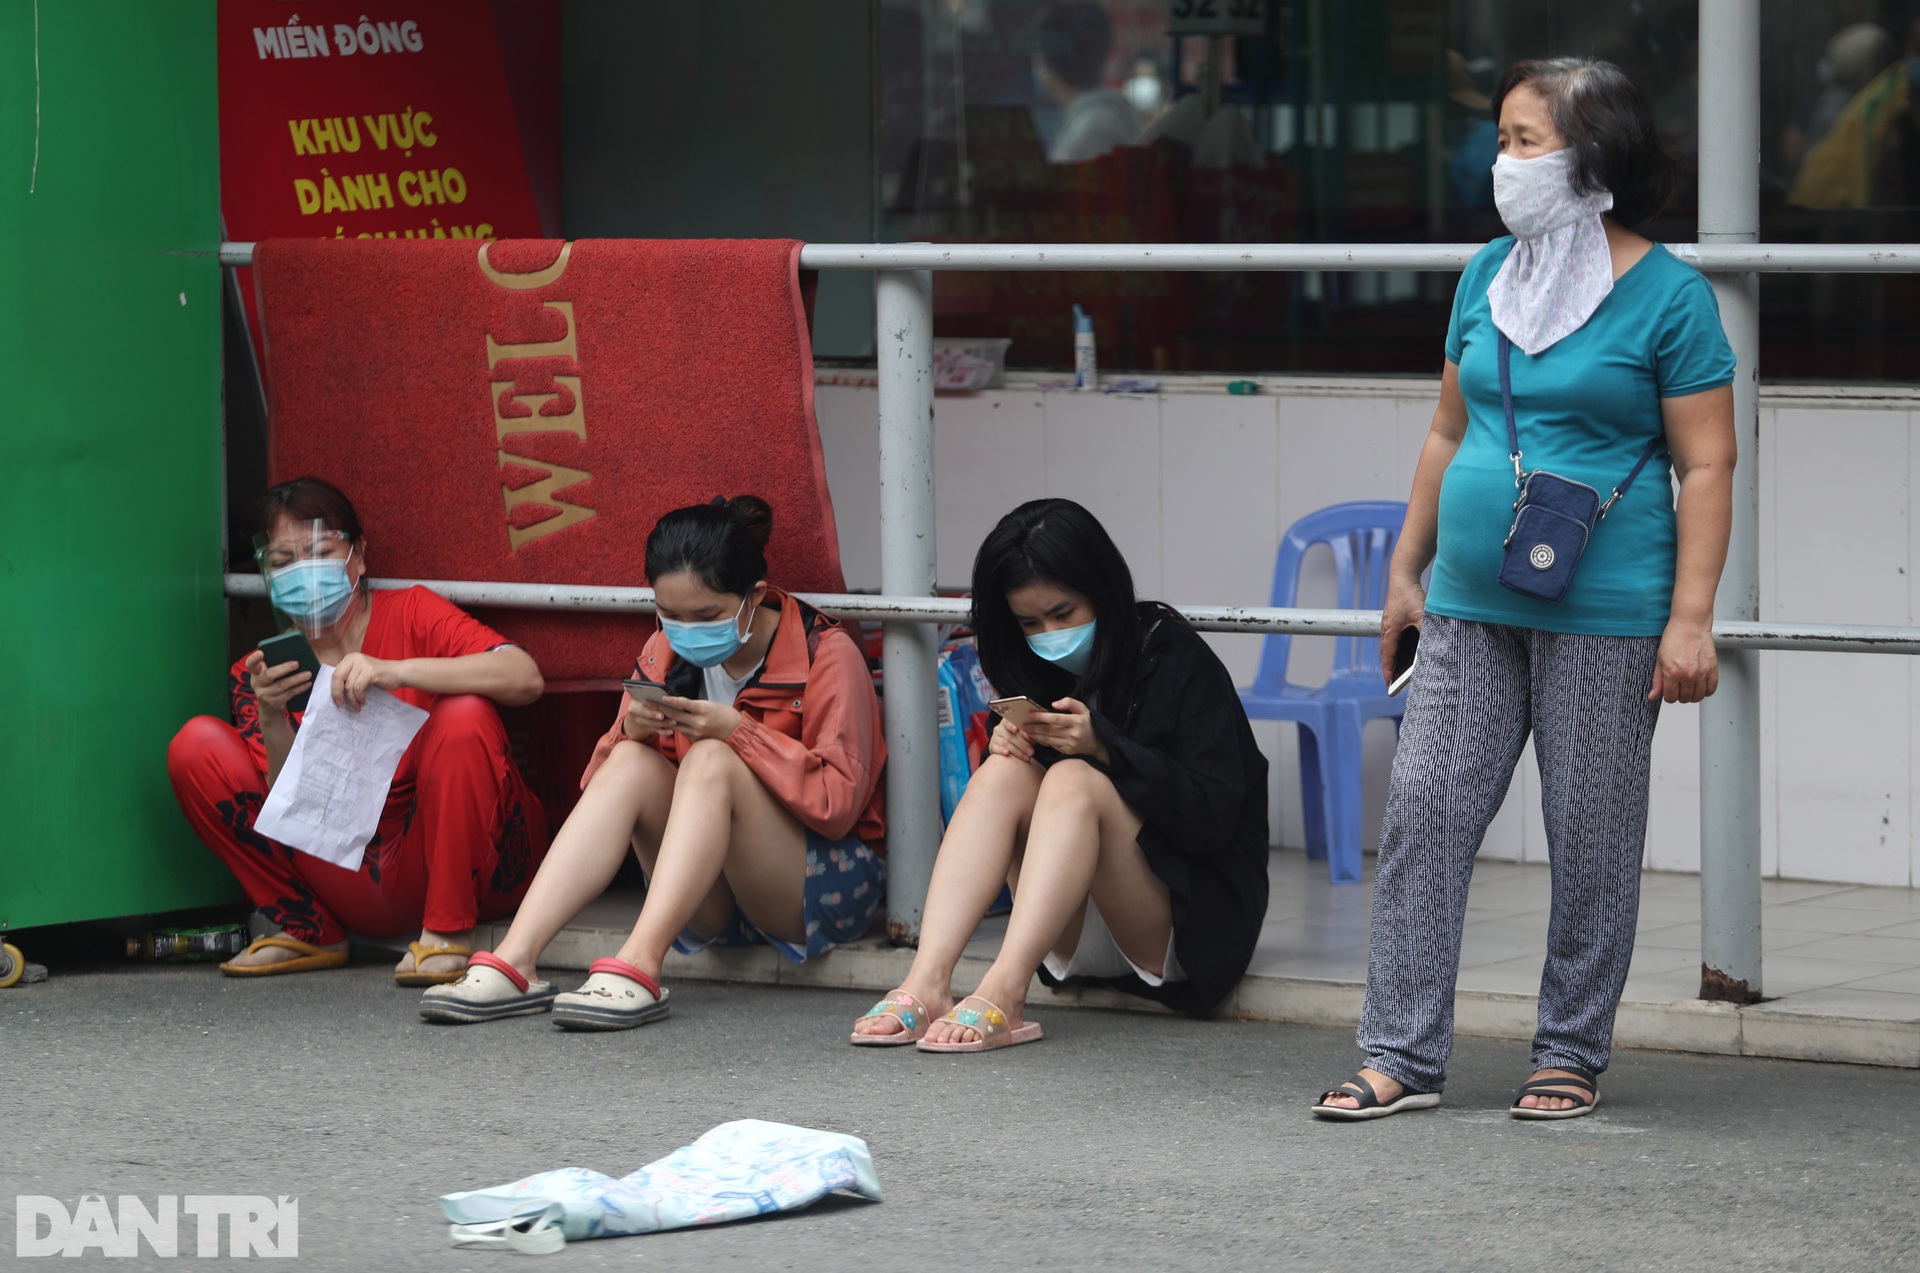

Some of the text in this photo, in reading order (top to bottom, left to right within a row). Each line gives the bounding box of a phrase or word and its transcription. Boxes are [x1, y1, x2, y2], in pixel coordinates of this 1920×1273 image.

[253, 13, 424, 60] MIỀN ĐÔNG
[288, 105, 439, 158] KHU VỰC
[294, 166, 468, 216] DÀNH CHO
